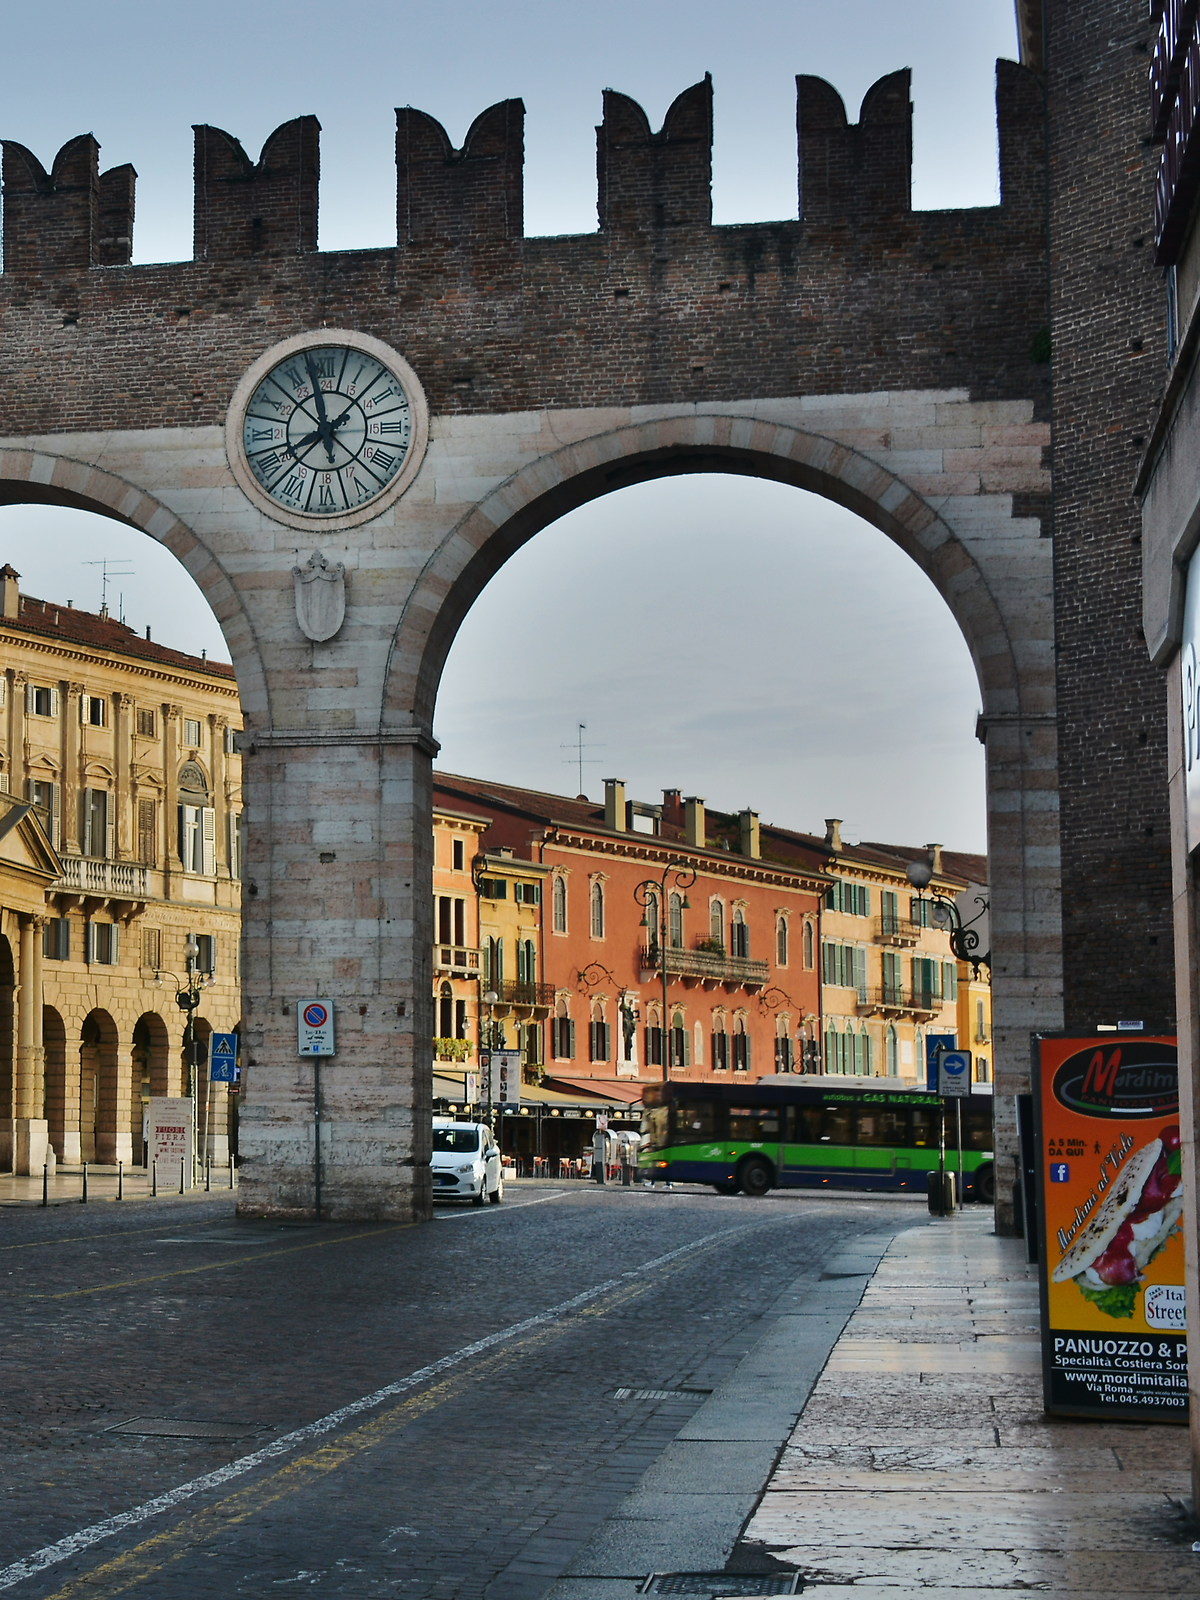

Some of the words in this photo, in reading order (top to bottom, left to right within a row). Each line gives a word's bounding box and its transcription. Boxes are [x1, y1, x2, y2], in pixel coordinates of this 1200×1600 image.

[283, 365, 306, 390] XI
[320, 380, 333, 391] 24
[346, 384, 356, 396] 13
[296, 386, 310, 399] 23
[261, 394, 282, 411] X
[363, 399, 373, 410] 14
[280, 404, 292, 416] 22
[274, 428, 284, 439] 21
[369, 423, 380, 435] 15
[279, 452, 293, 463] 20
[363, 447, 374, 458] 16
[298, 466, 308, 479] 19
[345, 466, 355, 478] 17
[321, 473, 332, 484] 18
[282, 475, 304, 500] VII
[353, 476, 370, 497] V
[318, 484, 337, 506] VI
[863, 1093, 885, 1103] GAS
[1049, 1139, 1055, 1147] A
[1058, 1139, 1065, 1147] 5
[1067, 1138, 1087, 1147] Min.
[1049, 1148, 1063, 1156] DA
[1065, 1148, 1084, 1156] QUI
[1057, 1165, 1066, 1181] f
[1054, 1337, 1154, 1356] PANUOZZO
[1158, 1343, 1171, 1358] &
[1055, 1354, 1112, 1367] Specialità
[1114, 1358, 1163, 1370] Costiera
[1064, 1372, 1187, 1388] www.mordimitalia
[1086, 1383, 1102, 1392] Via
[1104, 1384, 1133, 1394] Roma
[1099, 1393, 1118, 1403] Tel.
[1119, 1394, 1185, 1407] 045.4937003
